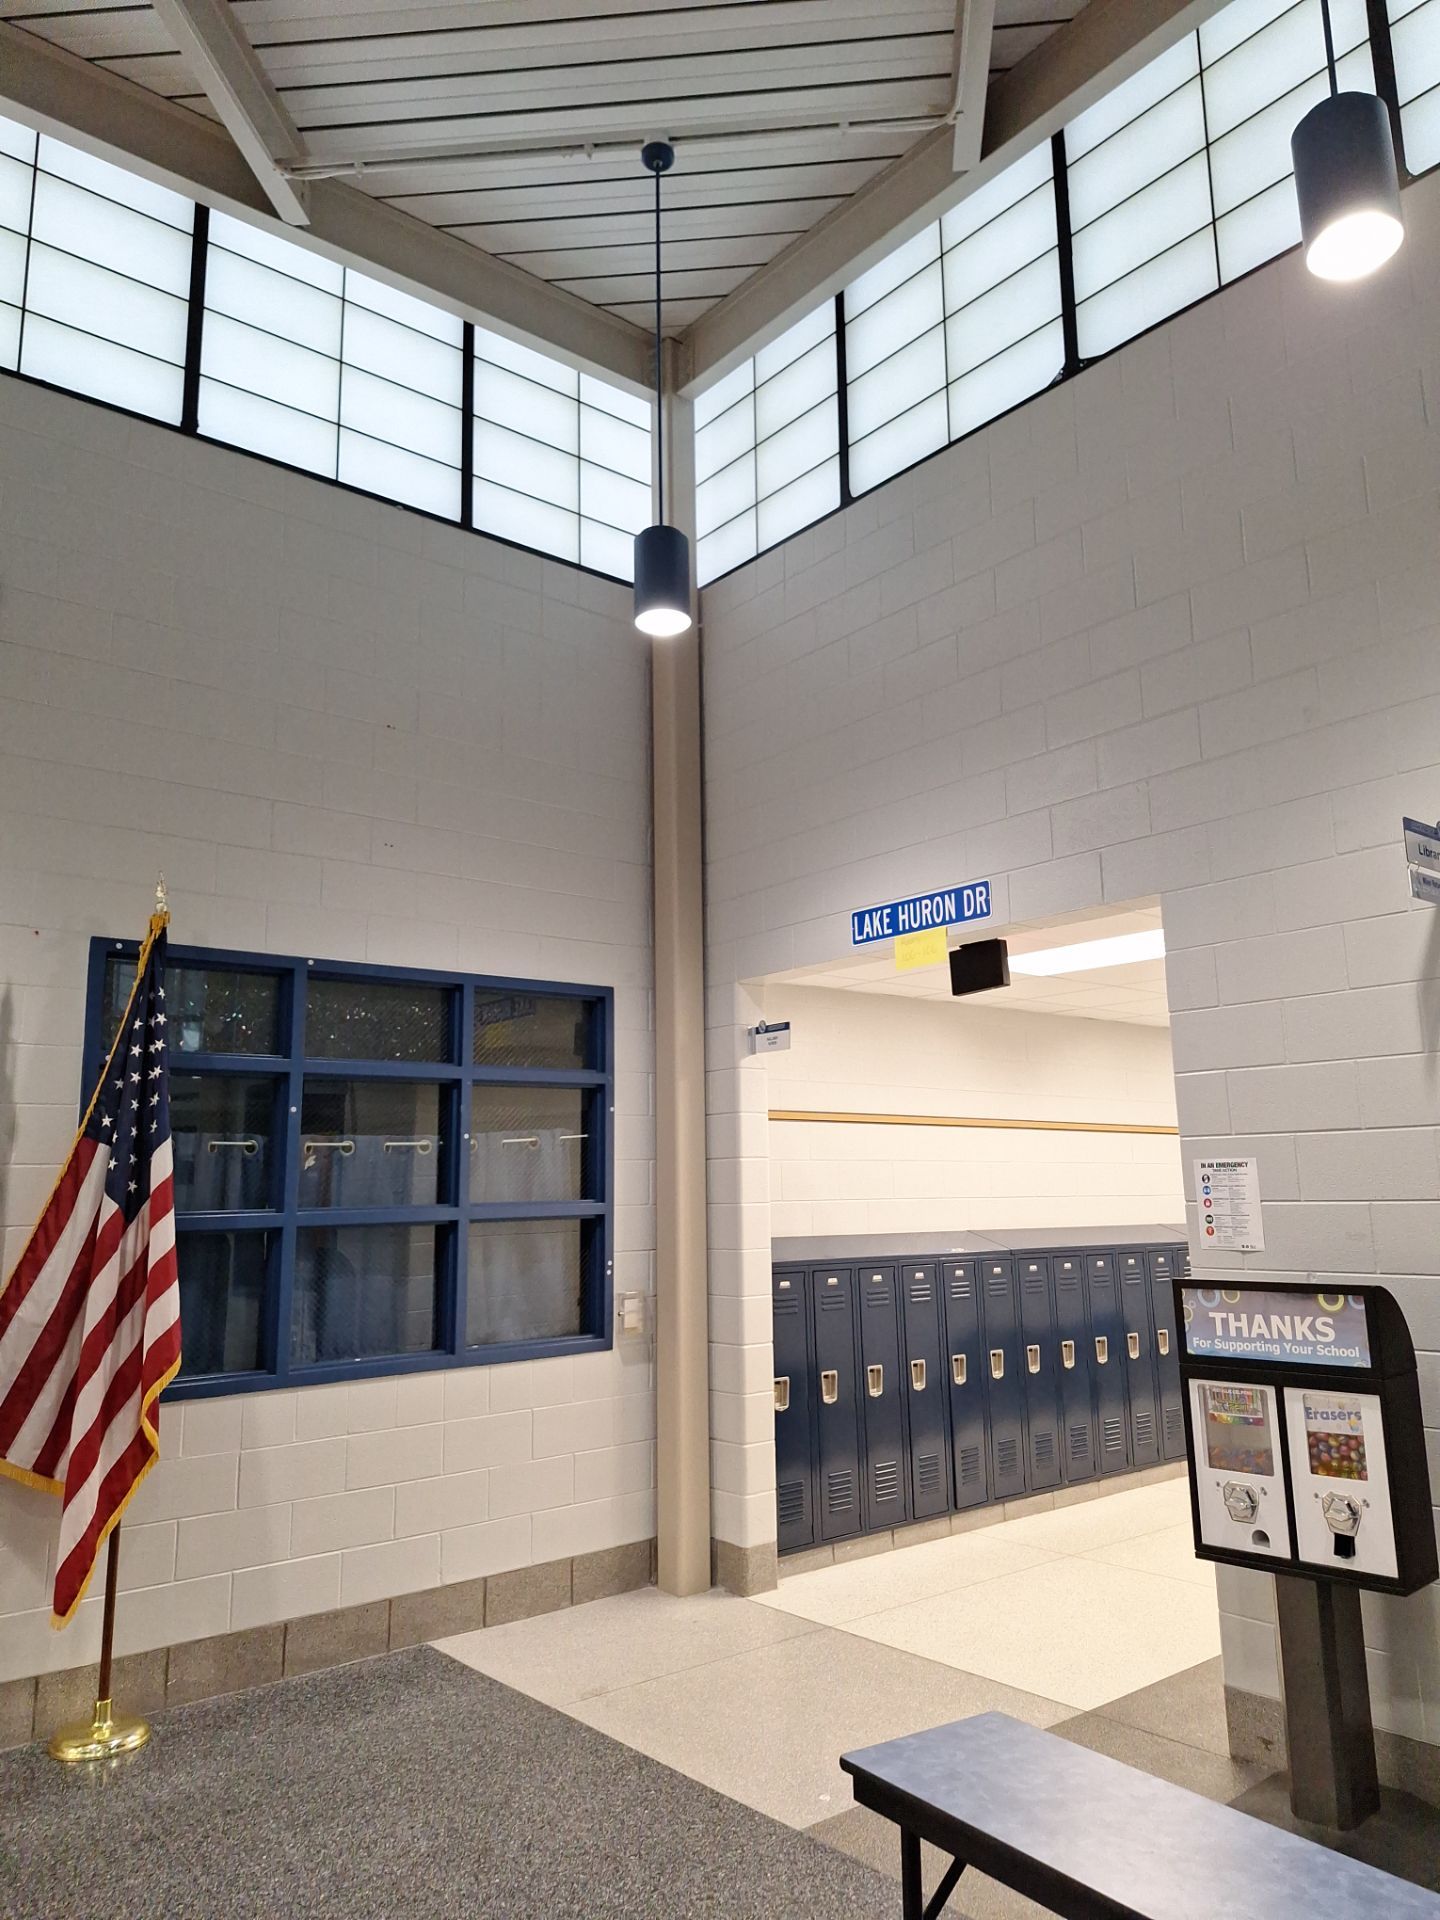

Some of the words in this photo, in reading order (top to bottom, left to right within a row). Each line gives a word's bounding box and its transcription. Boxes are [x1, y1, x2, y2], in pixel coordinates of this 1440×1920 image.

[854, 908, 892, 941] LAKE
[898, 893, 956, 931] HURON
[964, 886, 987, 917] DR
[1208, 1312, 1336, 1343] THANKS
[1192, 1337, 1211, 1349] For
[1214, 1338, 1280, 1355] Supporting
[1284, 1342, 1313, 1355] Your
[1316, 1344, 1360, 1358] School
[1304, 1406, 1362, 1421] Erasers
